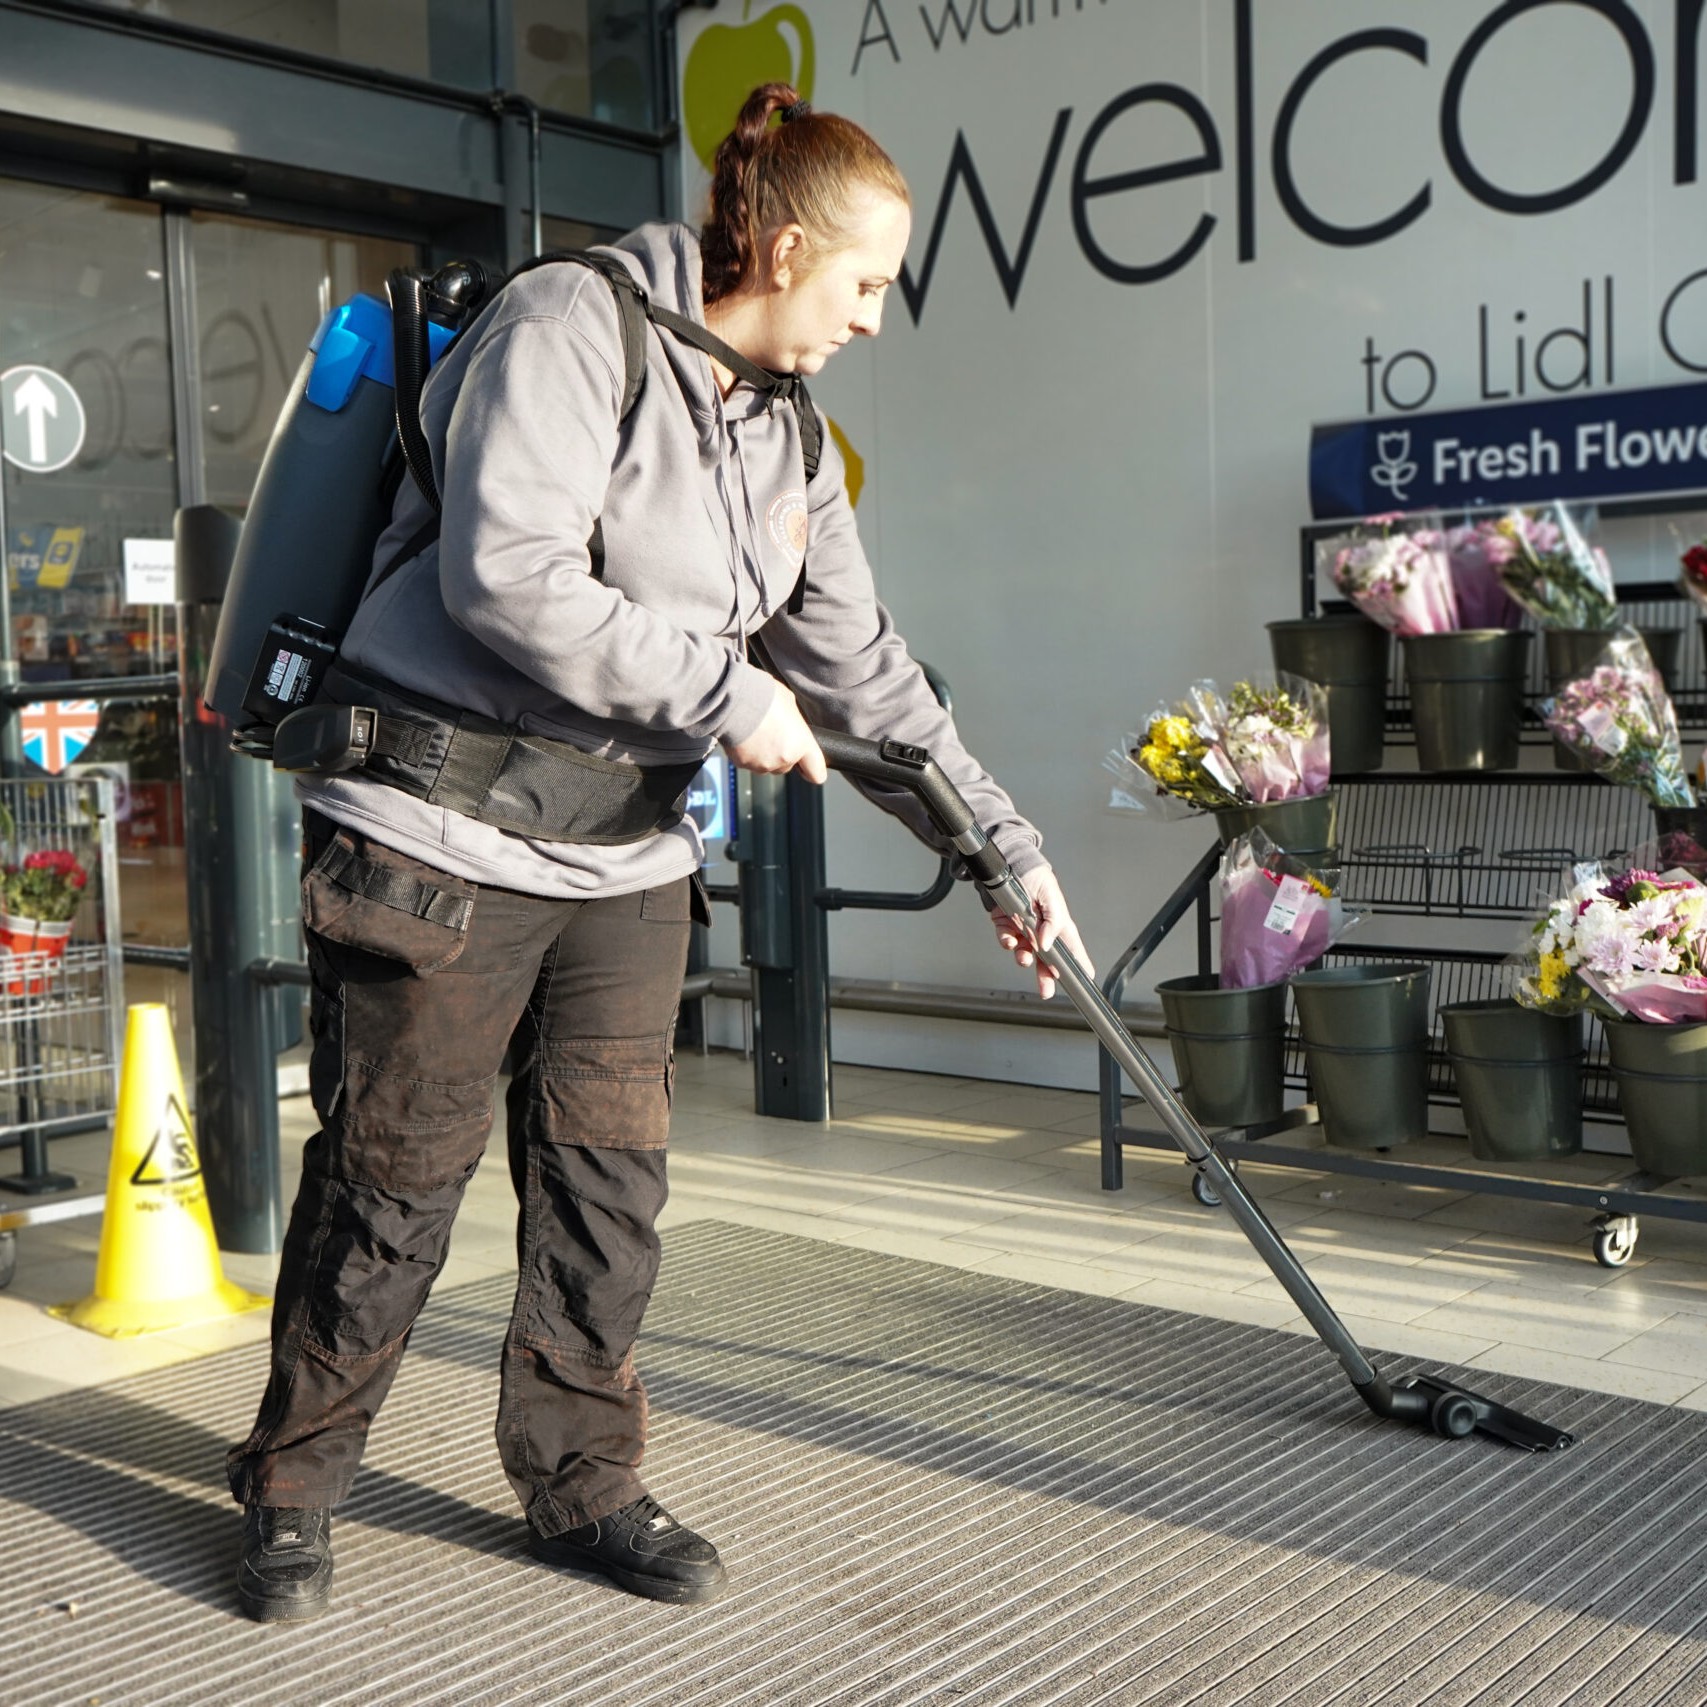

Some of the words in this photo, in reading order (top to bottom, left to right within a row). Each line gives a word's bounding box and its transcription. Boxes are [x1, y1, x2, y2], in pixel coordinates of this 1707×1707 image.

[851, 0, 901, 76] A
[918, 0, 1107, 51] wa
[1360, 336, 1438, 415] to
[1479, 275, 1614, 400] Lidl
[1433, 428, 1560, 484] Fresh
[8, 552, 40, 570] ers
